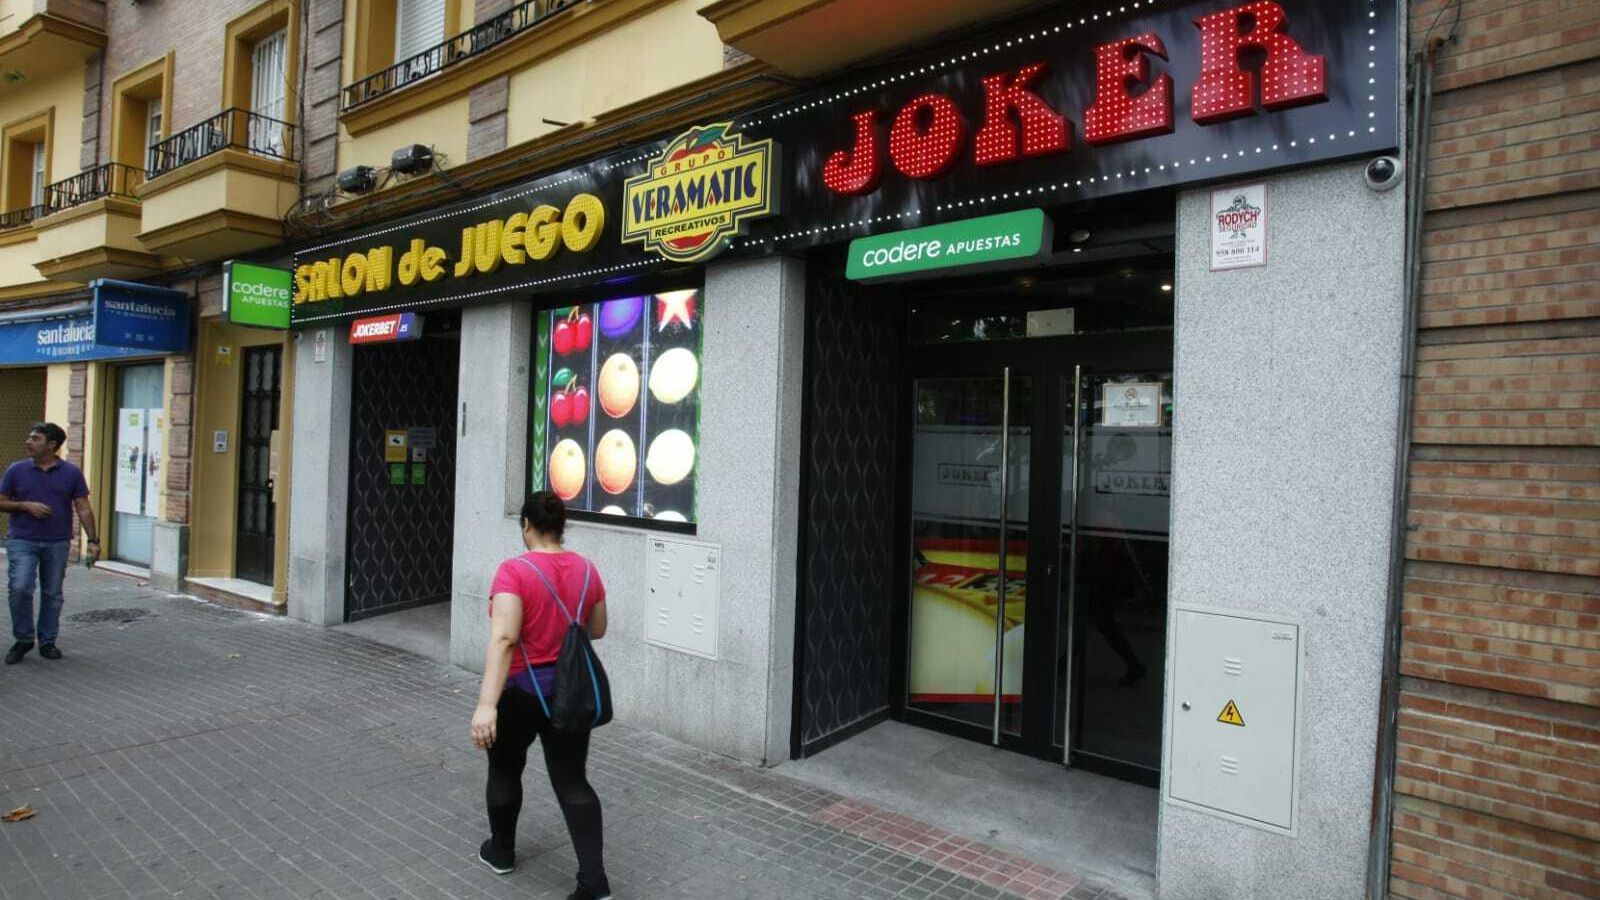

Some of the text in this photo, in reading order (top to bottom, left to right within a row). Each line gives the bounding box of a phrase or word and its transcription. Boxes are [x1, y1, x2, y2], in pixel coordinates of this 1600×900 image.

[823, 0, 1329, 195] JOKER
[660, 150, 726, 176] GRUPO
[632, 161, 758, 224] VERAMATIC
[655, 215, 726, 237] RECREATIVOS
[1218, 211, 1257, 225] RODYCH
[294, 193, 605, 305] SALON de JUEGO
[863, 233, 1021, 267] codere APUESTAS
[232, 282, 289, 299] codere
[241, 295, 289, 308] APUESTAS
[353, 319, 397, 338] JOKERBET
